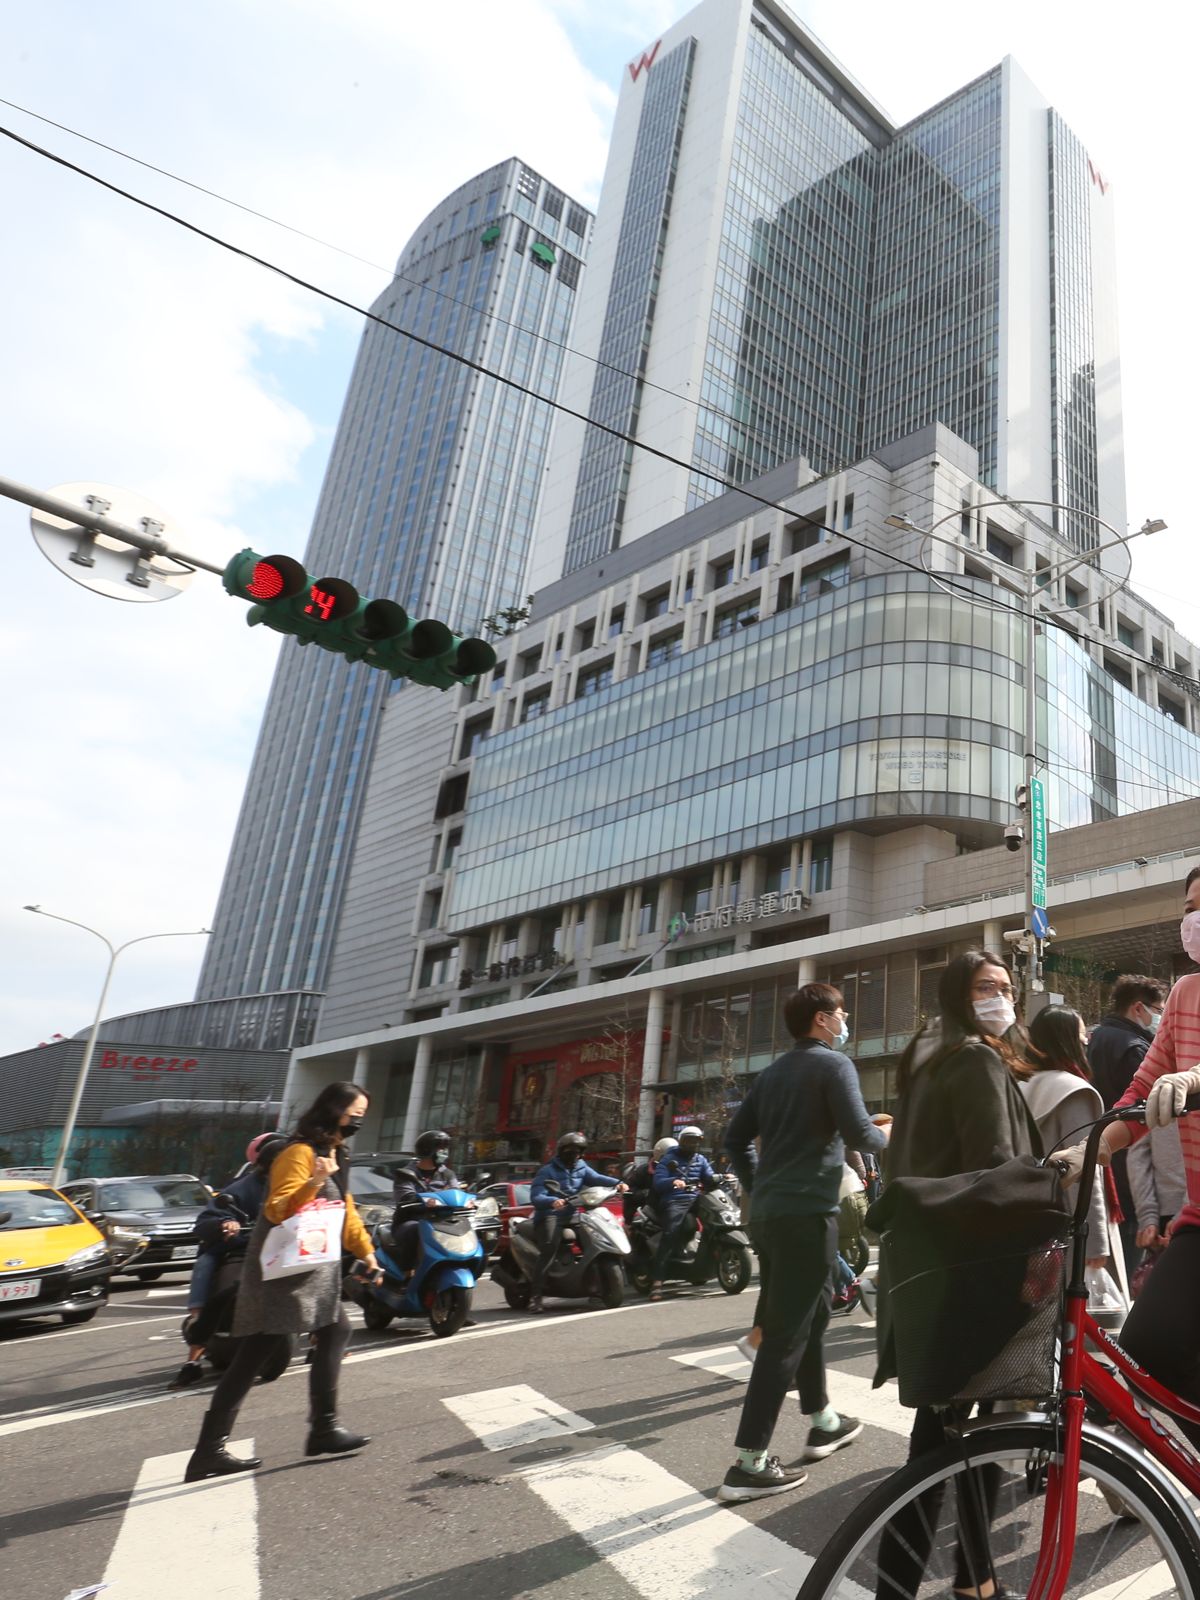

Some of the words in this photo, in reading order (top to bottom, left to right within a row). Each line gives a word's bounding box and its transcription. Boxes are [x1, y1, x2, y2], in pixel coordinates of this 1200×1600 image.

[629, 39, 662, 82] W
[693, 887, 802, 933] 市府轉運站
[100, 1049, 198, 1072] Breeze
